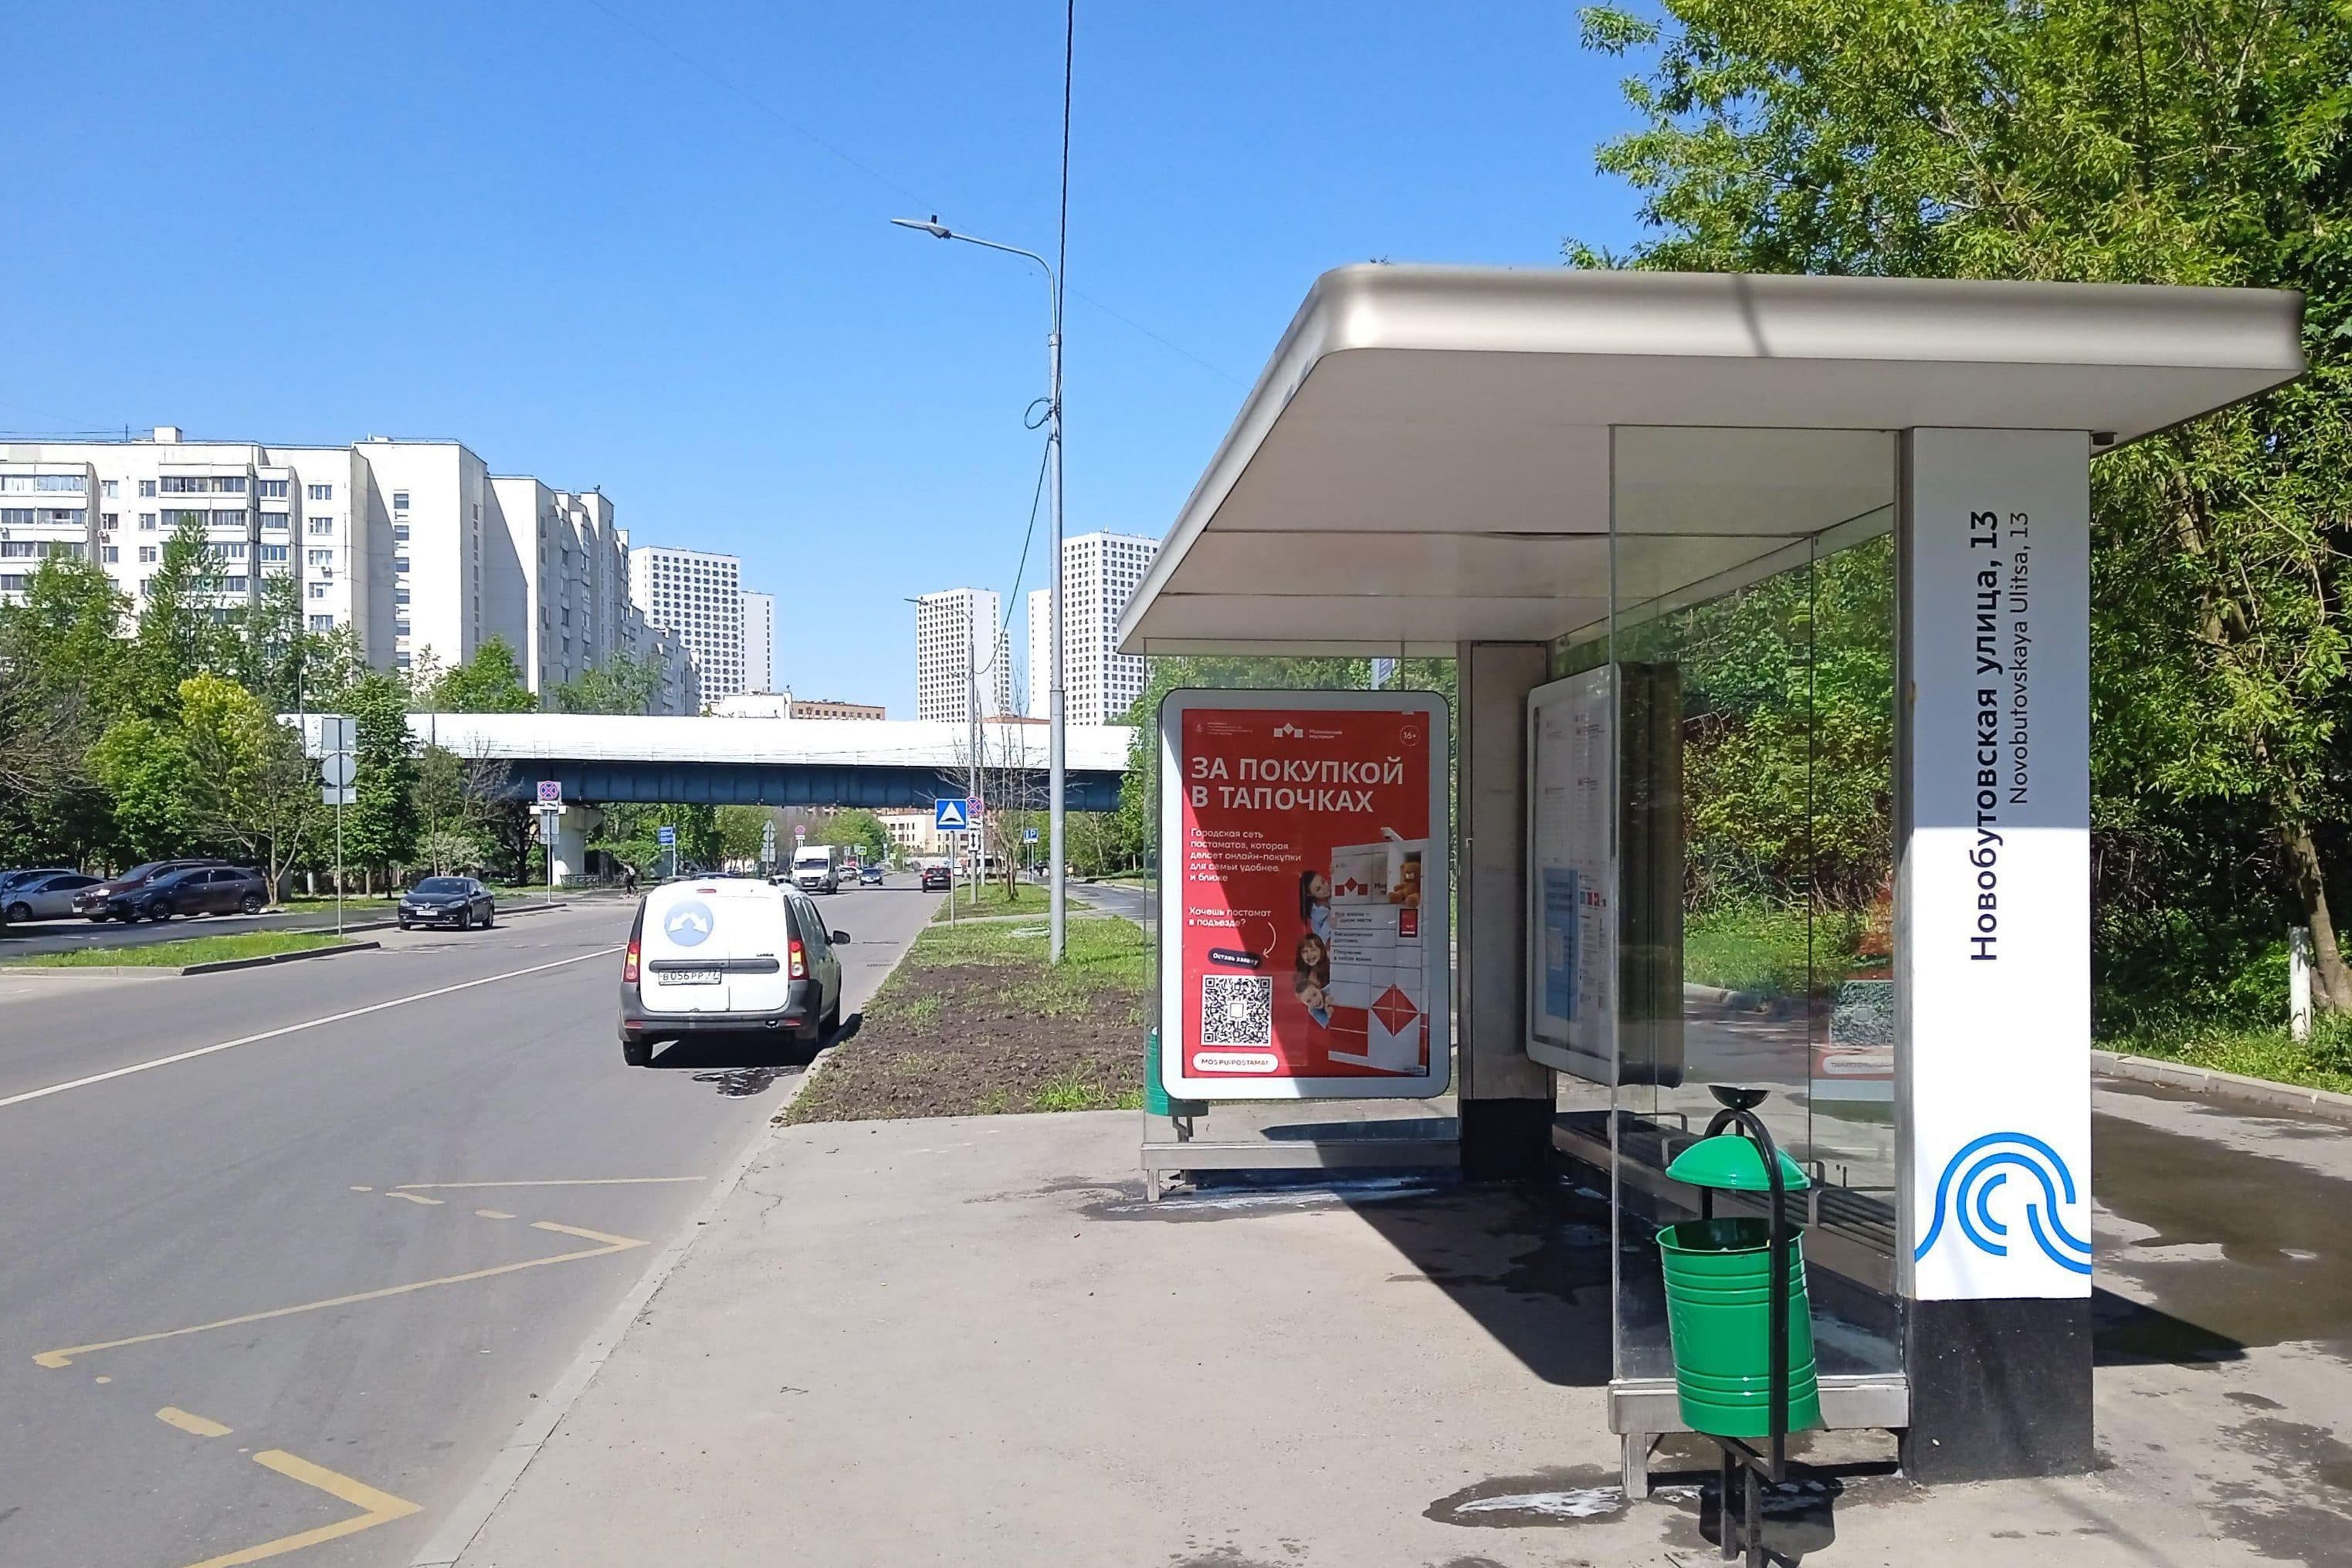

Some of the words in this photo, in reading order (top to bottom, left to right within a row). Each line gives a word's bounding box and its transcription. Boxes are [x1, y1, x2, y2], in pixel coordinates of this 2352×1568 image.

[1971, 511, 1998, 548] 13
[2010, 513, 2028, 537] 13
[2009, 545, 2031, 613] Ulitsa,
[1977, 560, 2003, 676] улица,
[2008, 621, 2032, 803] Novobutovskaya
[1191, 757, 1229, 780] ЗА
[1240, 756, 1404, 785] ПОКУПКОЙ
[1191, 786, 1209, 808] В
[1218, 786, 1374, 813] ТАПОЧКАХ
[1970, 689, 2003, 960] Новобутовская
[1191, 828, 1241, 840] Городская
[1190, 840, 1249, 850] постаматов,
[1251, 842, 1289, 852] которая
[1190, 852, 1223, 860] делает
[1225, 852, 1302, 862] онлайн-покупки
[1240, 863, 1279, 873] удобнее
[1198, 873, 1229, 882] ближе
[1189, 906, 1225, 916] Хочешь
[1227, 909, 1272, 917] постамат
[1196, 918, 1246, 928] подъезде?
[1201, 1058, 1269, 1066] MOSU/POSTAMAT
